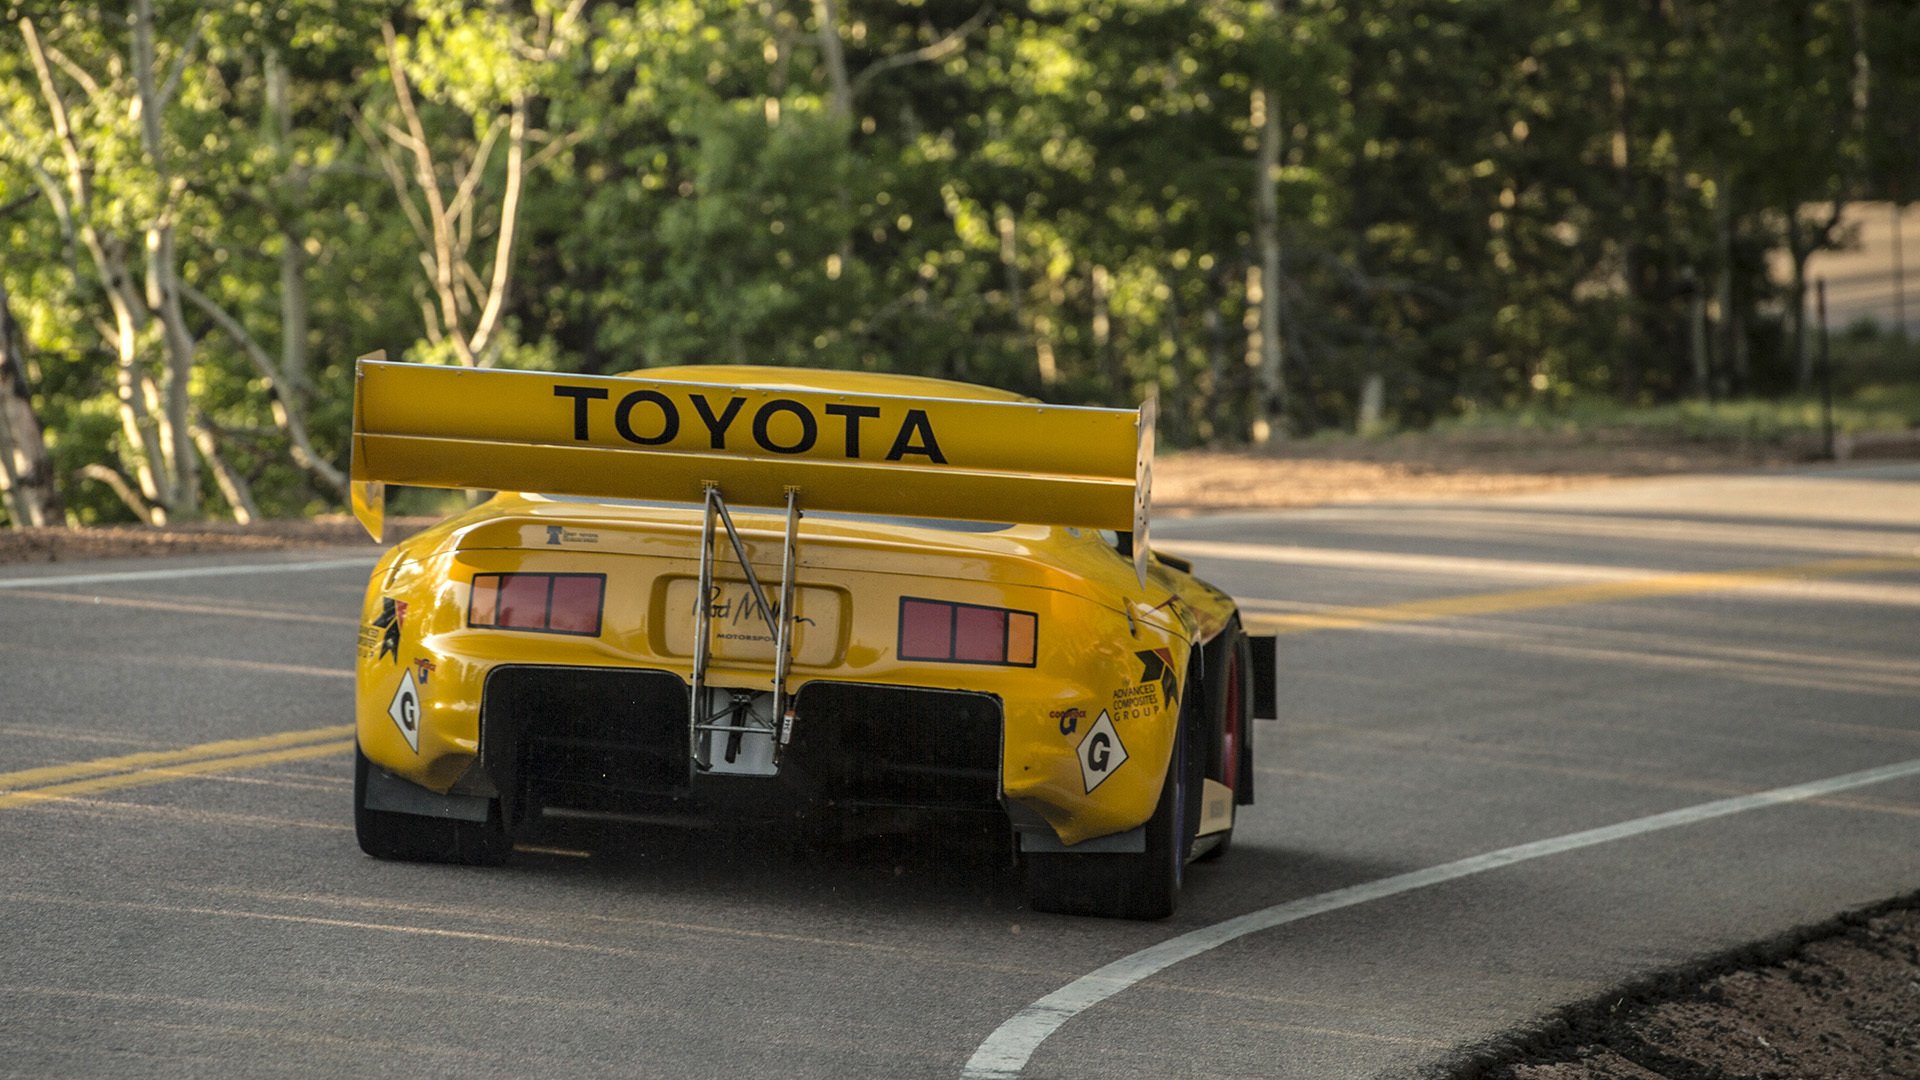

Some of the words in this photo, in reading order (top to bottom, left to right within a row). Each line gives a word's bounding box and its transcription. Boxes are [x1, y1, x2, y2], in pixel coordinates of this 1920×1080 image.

[553, 385, 949, 465] TOYOTA
[717, 633, 778, 642] MOTORSPO
[1113, 684, 1156, 699] ADVANCED
[1113, 694, 1158, 711] COMPOSITES
[401, 691, 416, 732] G
[1114, 706, 1160, 722] GROUP
[1088, 732, 1111, 772] G
